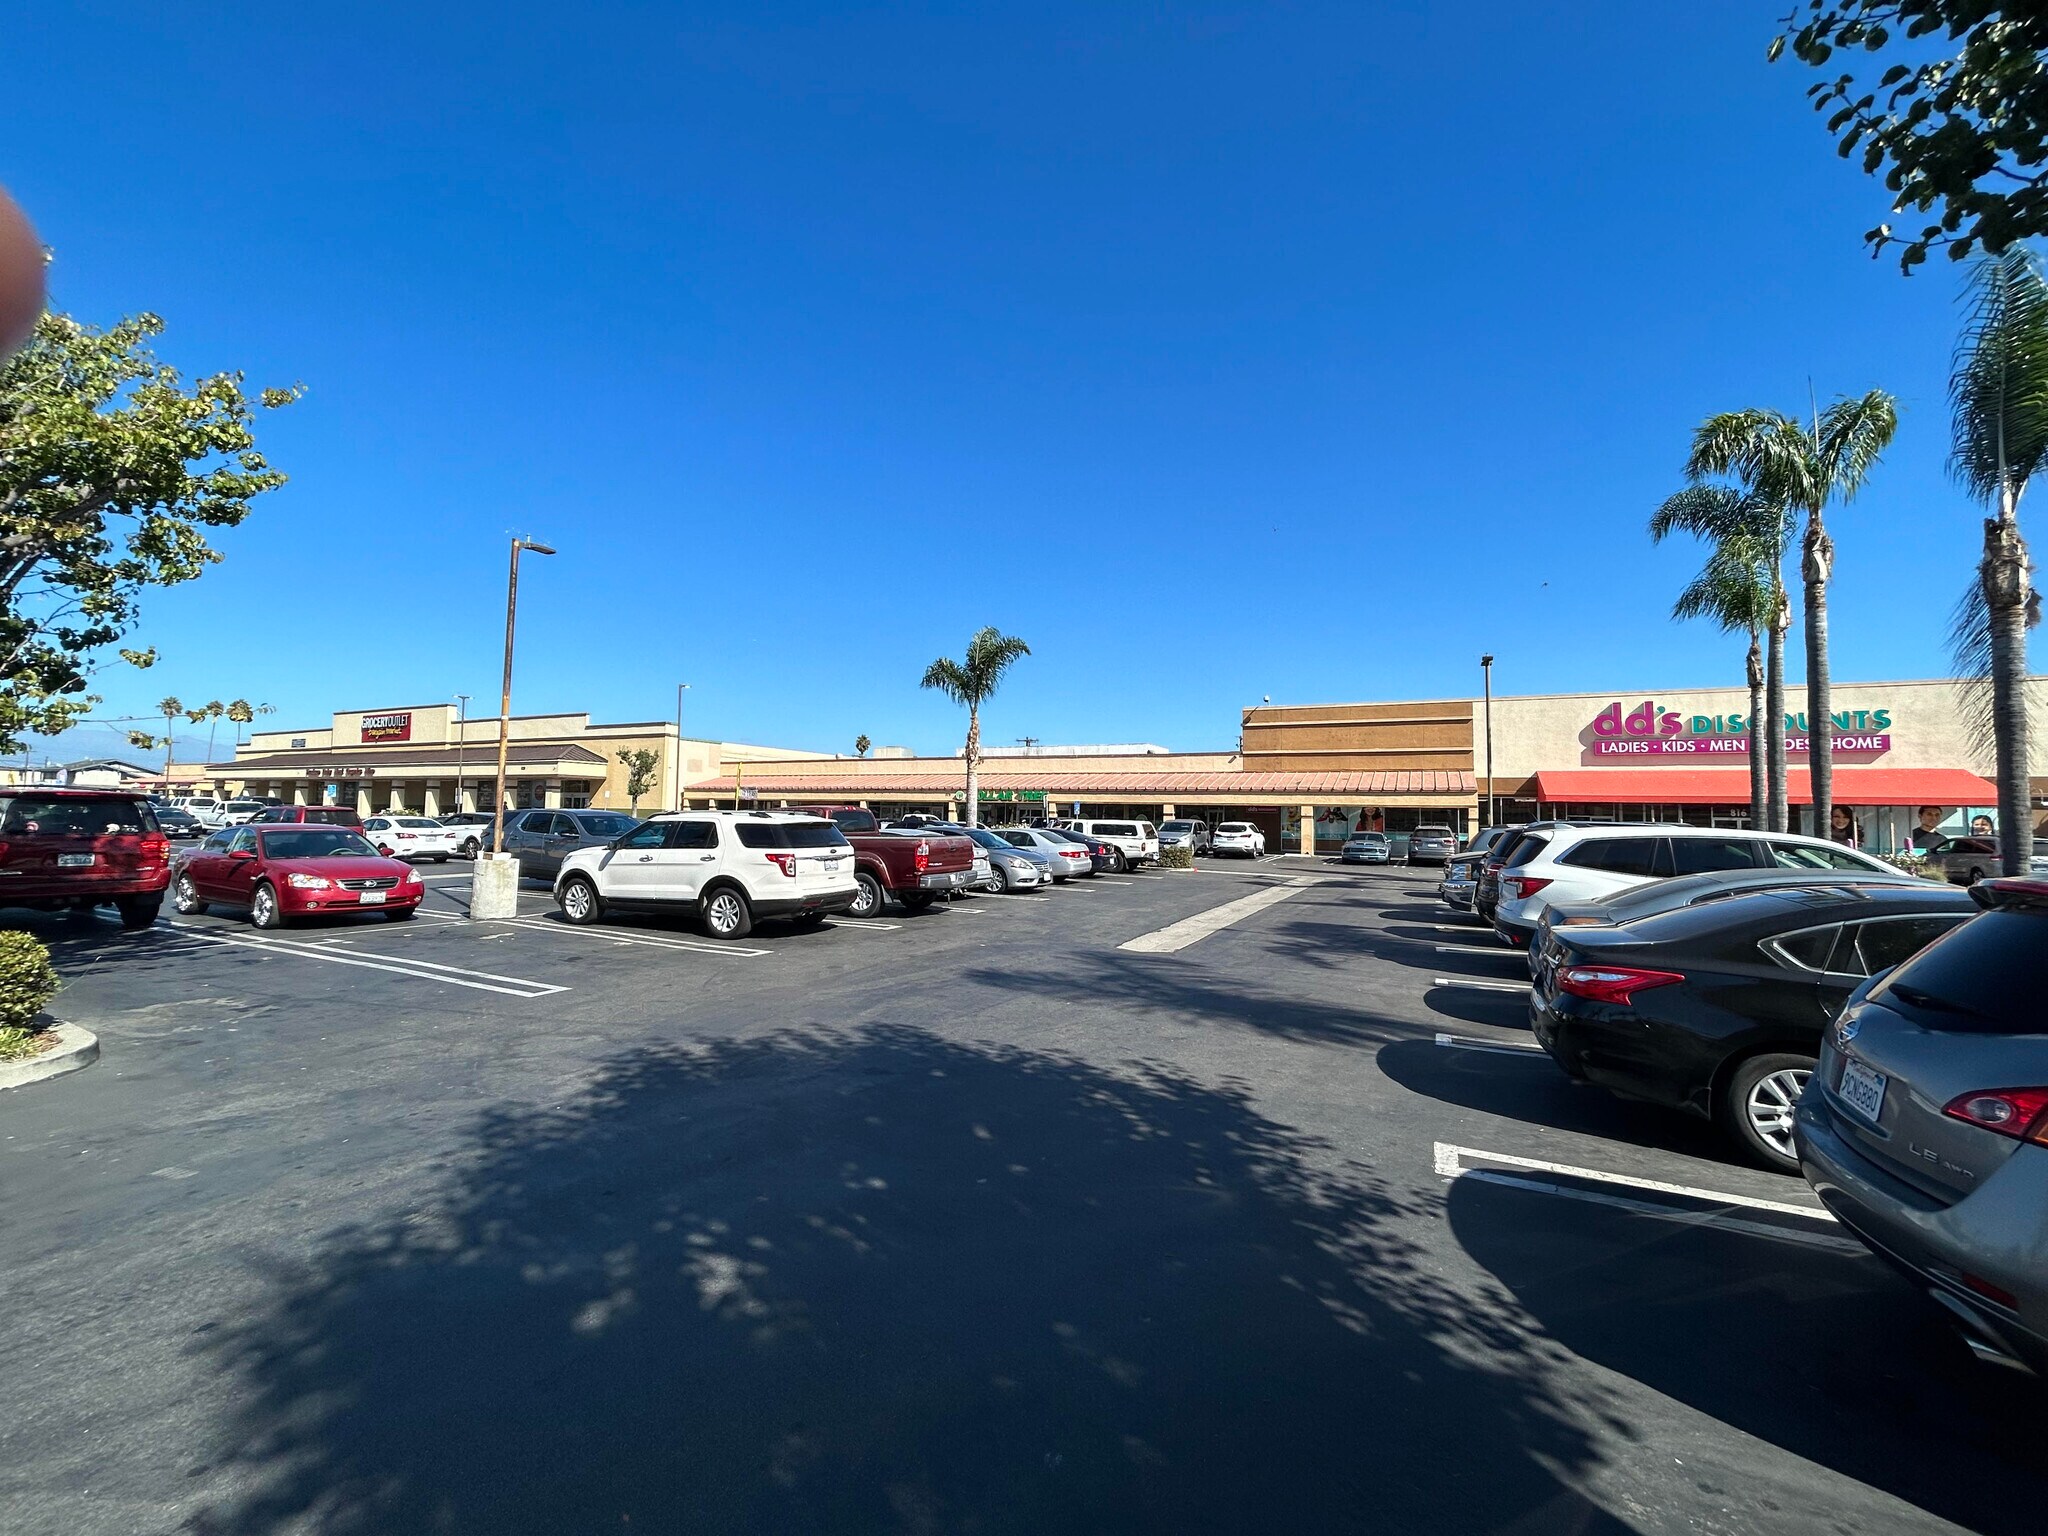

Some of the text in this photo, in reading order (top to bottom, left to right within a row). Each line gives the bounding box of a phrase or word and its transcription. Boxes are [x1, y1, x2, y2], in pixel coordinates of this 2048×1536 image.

[1593, 701, 1682, 736] dd's
[1601, 736, 1883, 753] LADIES KIDS MEN SOES HOME
[977, 789, 1014, 800] OLLAR
[1730, 809, 1747, 817] 816
[1841, 1072, 1879, 1112] 9CNG880
[1908, 1142, 1939, 1164] LE
